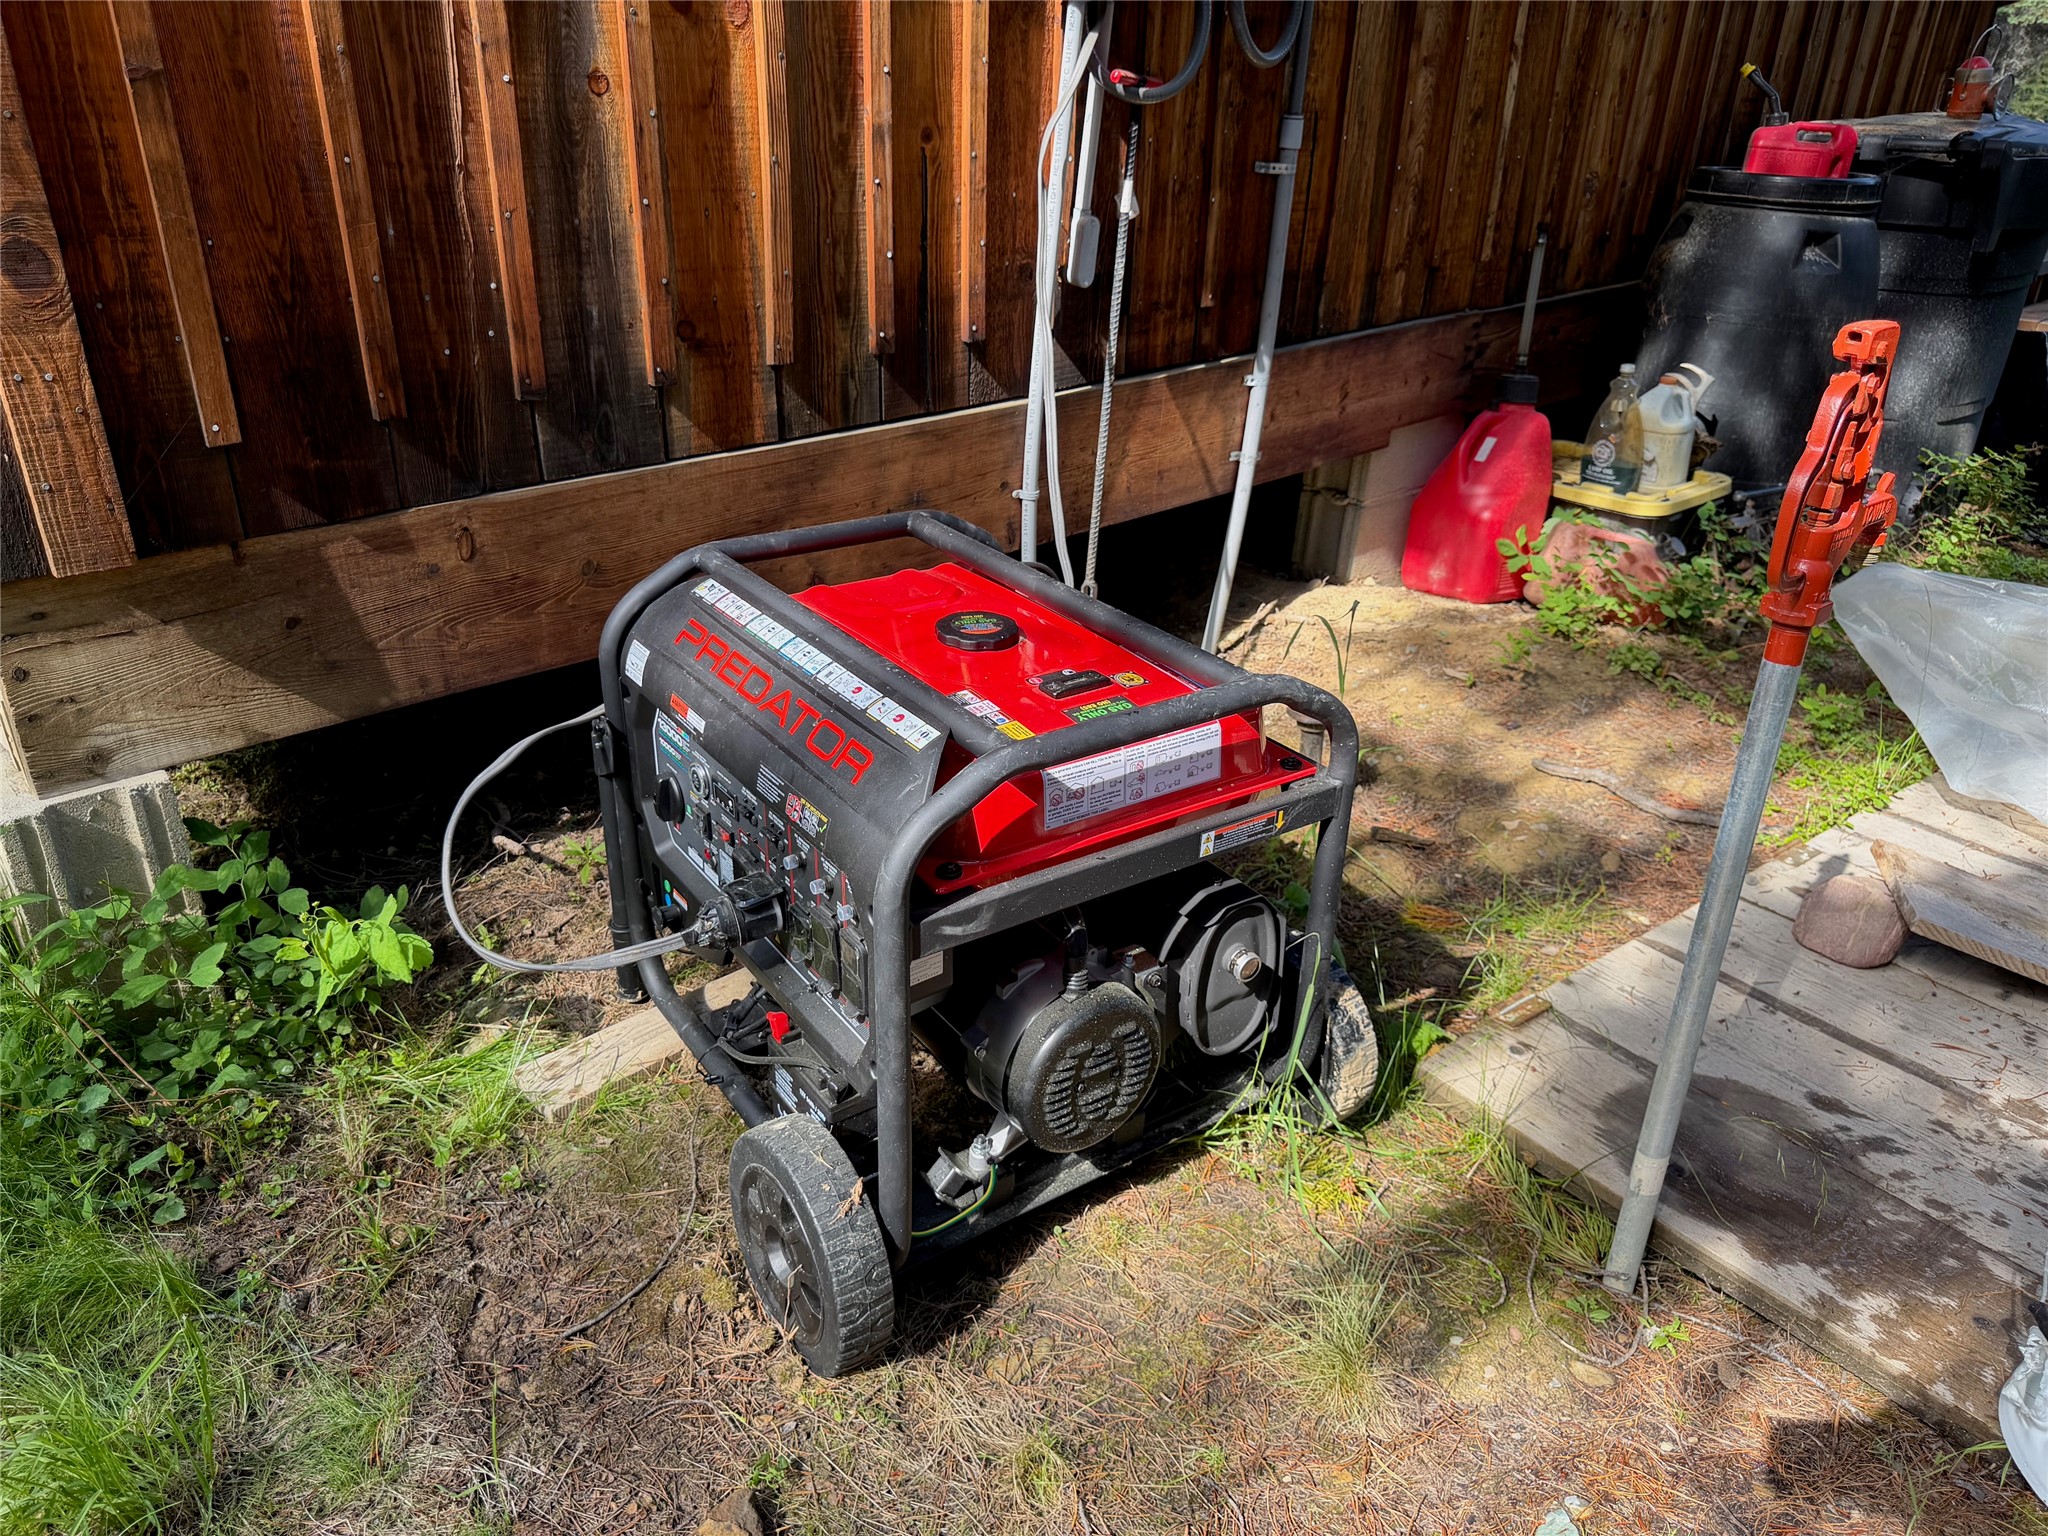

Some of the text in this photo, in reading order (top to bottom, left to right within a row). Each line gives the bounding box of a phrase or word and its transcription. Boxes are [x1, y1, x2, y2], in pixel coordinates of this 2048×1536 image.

[1052, 122, 1065, 177] RESISTANT
[673, 617, 876, 786] PREDATOR
[1077, 709, 1108, 722] ONLY
[1109, 701, 1133, 714] GAS
